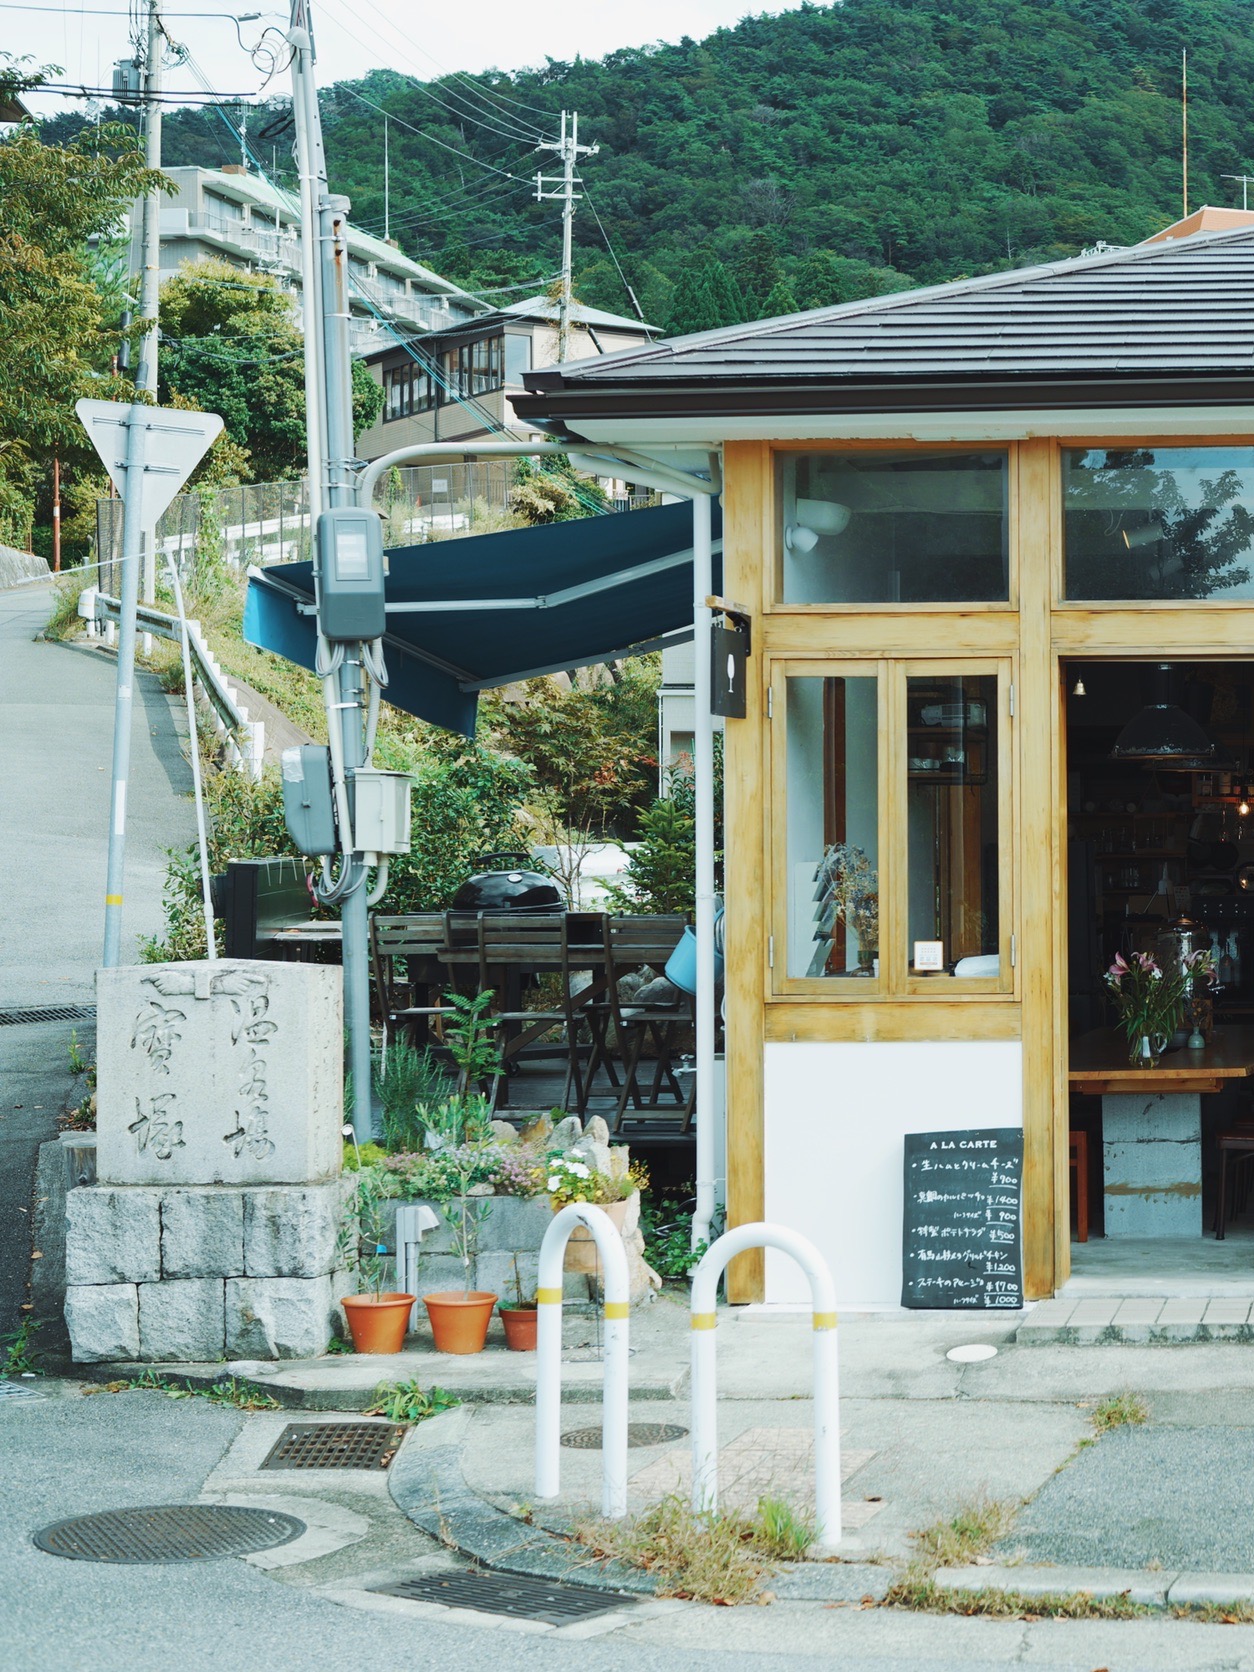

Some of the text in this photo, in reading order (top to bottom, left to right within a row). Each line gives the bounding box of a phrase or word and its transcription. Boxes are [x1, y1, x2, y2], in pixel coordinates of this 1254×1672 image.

[930, 1140, 997, 1150] A LA CARTE
